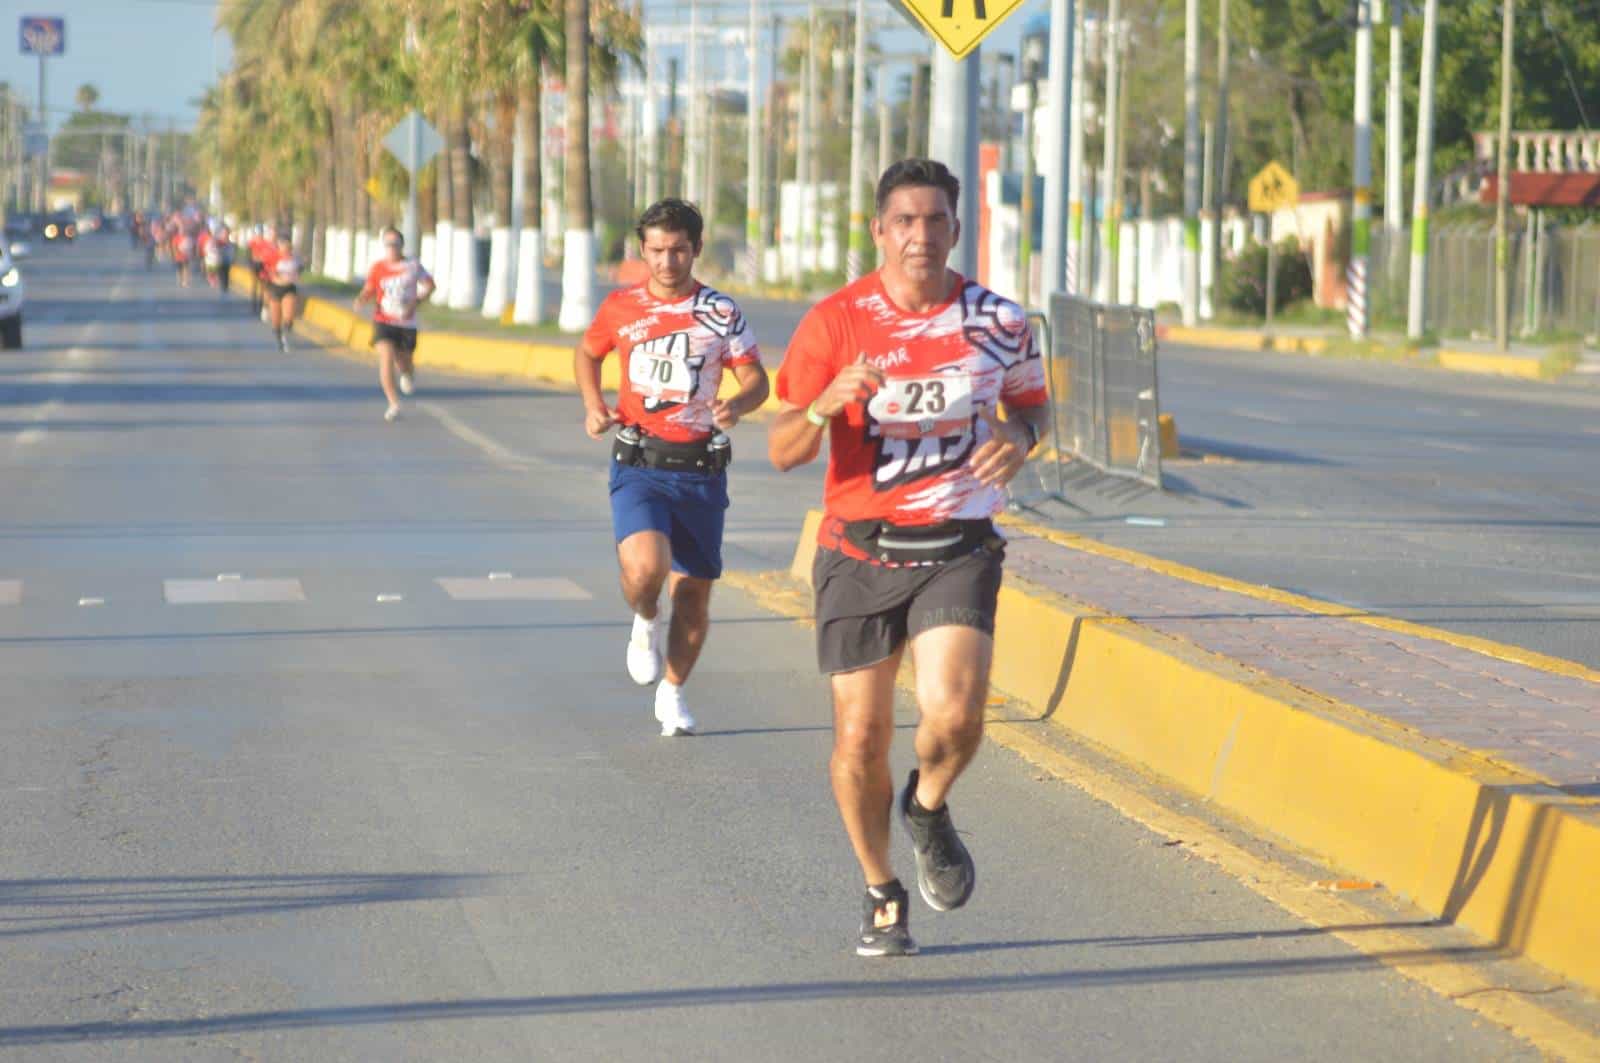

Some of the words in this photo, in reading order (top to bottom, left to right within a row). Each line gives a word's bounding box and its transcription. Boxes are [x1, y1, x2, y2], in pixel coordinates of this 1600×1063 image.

[867, 346, 912, 369] GAR
[649, 358, 673, 383] 70
[904, 380, 946, 415] 23
